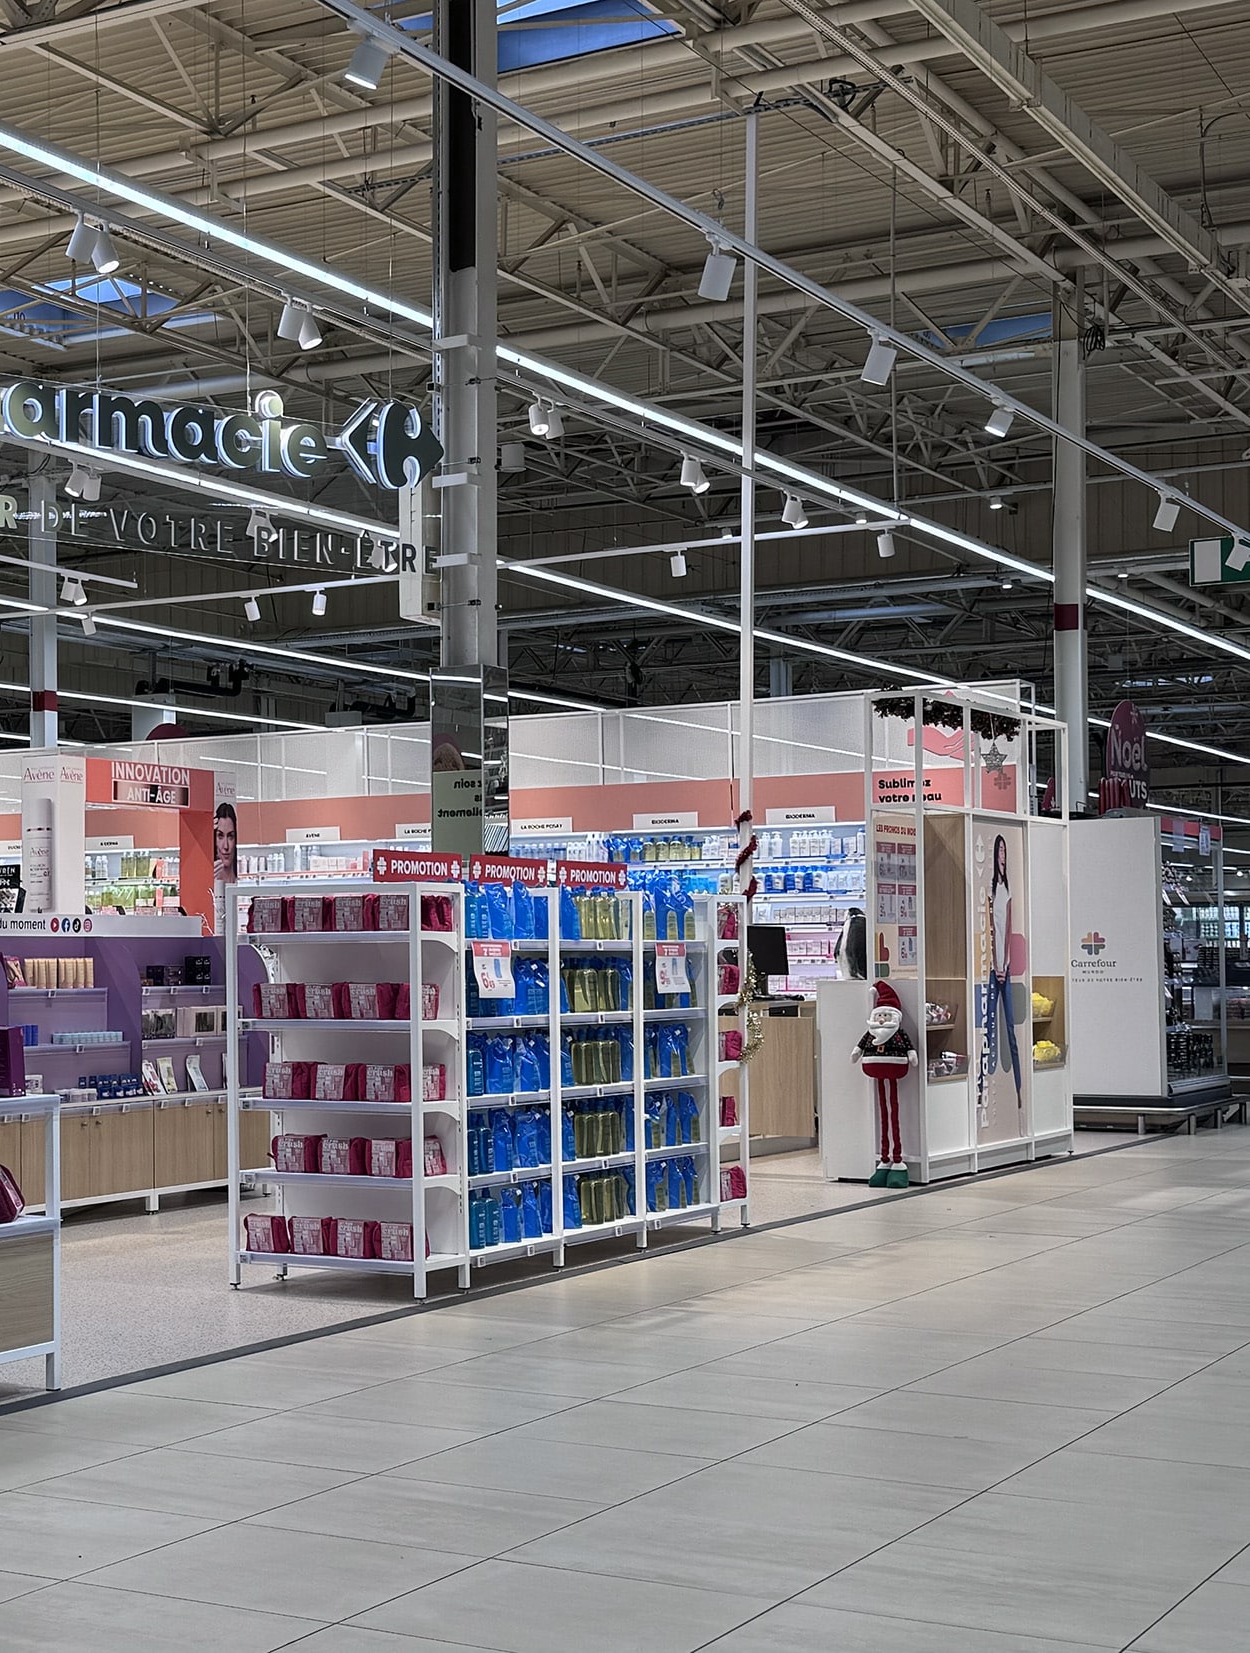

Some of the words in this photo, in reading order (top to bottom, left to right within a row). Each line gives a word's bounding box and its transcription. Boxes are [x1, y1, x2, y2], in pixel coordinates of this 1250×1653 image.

[41, 500, 90, 537] DE
[109, 507, 236, 554] VOTRE
[253, 523, 439, 575] BIEN-ÊTRE
[23, 767, 55, 783] Avène
[60, 766, 84, 782] Avène
[111, 761, 190, 786] INNOVATION
[126, 786, 177, 804] ANTI-ÂGE
[878, 793, 910, 803] votre
[391, 859, 448, 876] PROMOTION
[485, 863, 535, 881] PROMOTION
[570, 868, 616, 884] PROMOTION
[10, 918, 46, 931] moment
[1071, 958, 1117, 968] Carrefour
